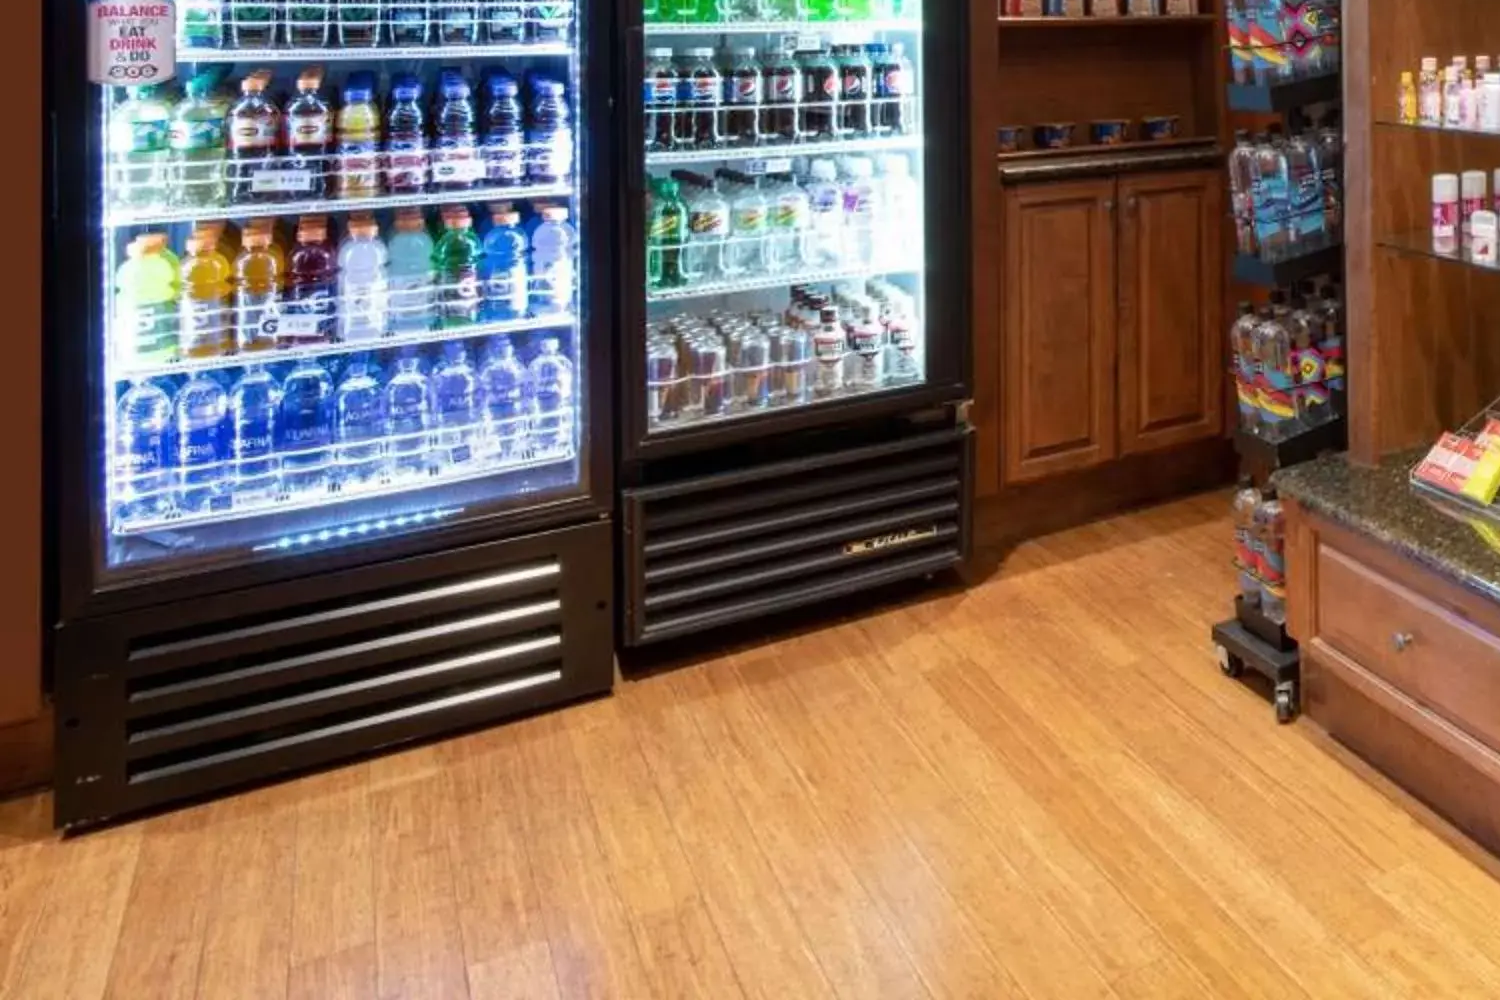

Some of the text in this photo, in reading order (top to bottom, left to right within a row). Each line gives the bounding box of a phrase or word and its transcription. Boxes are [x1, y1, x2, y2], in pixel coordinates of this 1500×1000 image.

[97, 5, 169, 18] BALANCE
[119, 26, 146, 37] EAT
[109, 38, 157, 50] DRINK
[129, 51, 152, 62] DO
